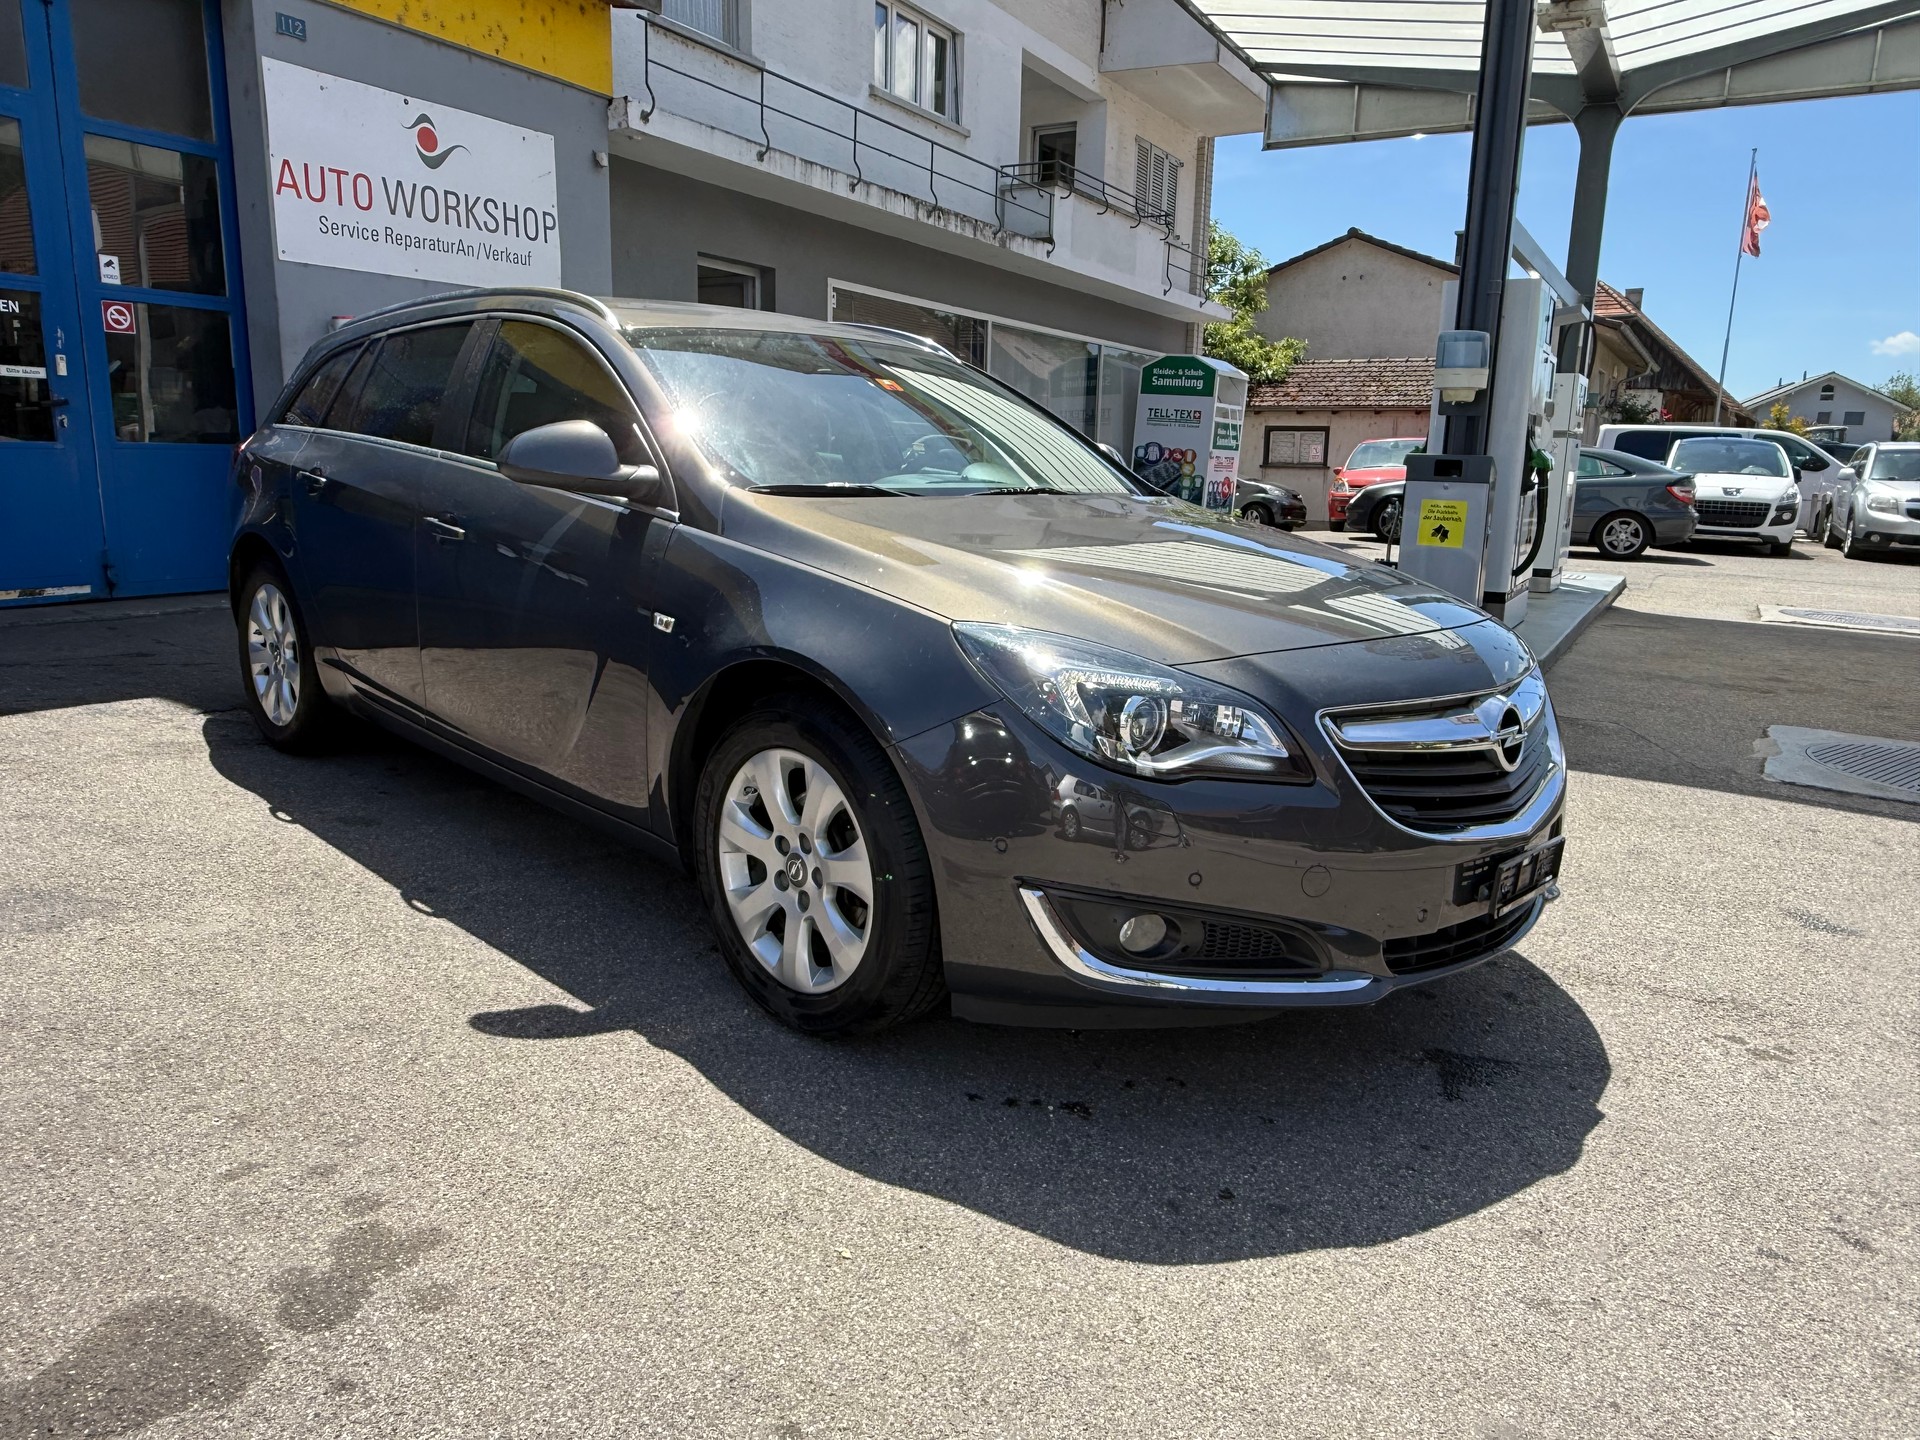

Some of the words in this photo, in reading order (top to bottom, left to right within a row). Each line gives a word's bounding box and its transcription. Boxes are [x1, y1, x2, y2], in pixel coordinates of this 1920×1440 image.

[281, 16, 304, 36] 112
[276, 158, 373, 211] AUTO
[381, 176, 556, 243] WORKSHOP
[318, 215, 379, 242] Service
[384, 226, 533, 267] ReparaturAn/Verkauf
[0, 299, 20, 313] EN
[1152, 375, 1204, 390] Sammlung
